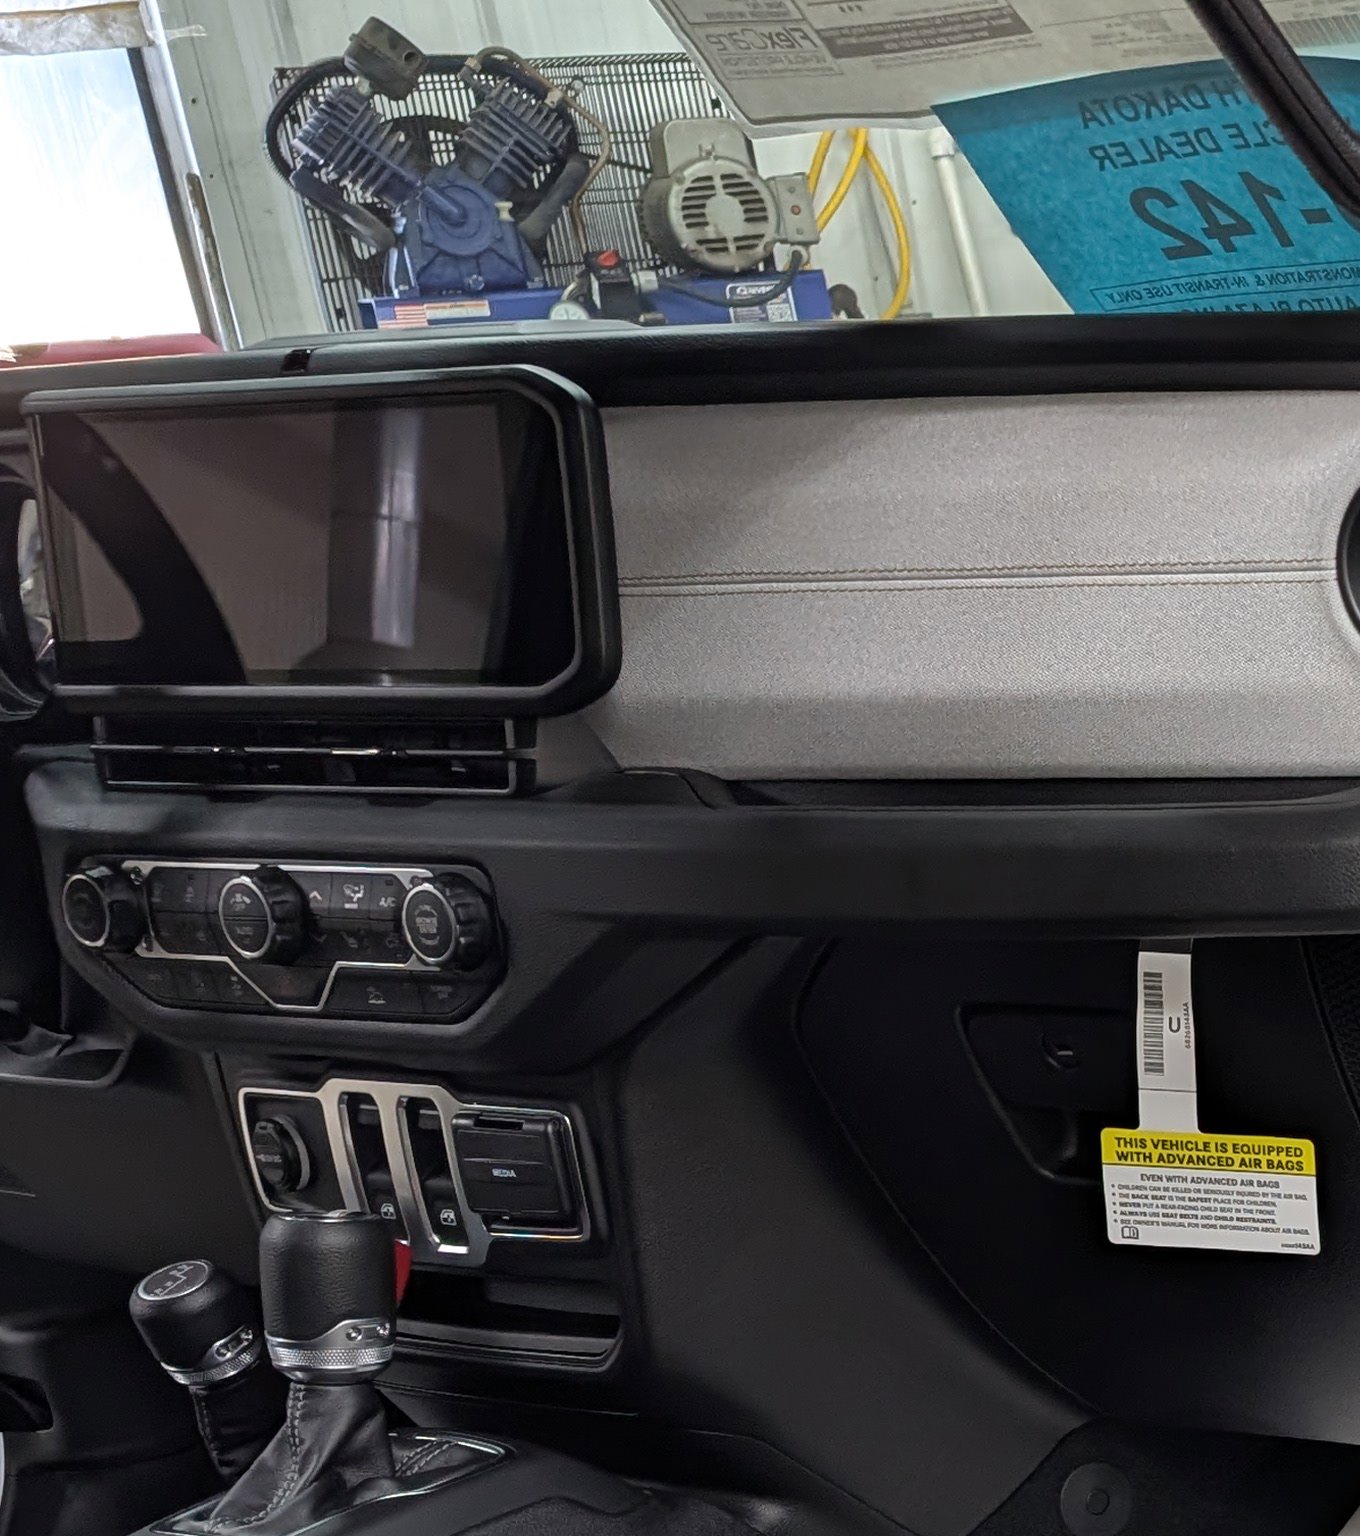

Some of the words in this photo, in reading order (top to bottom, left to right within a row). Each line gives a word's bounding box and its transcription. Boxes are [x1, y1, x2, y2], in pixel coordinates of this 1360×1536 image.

[1168, 1016, 1181, 1033] U
[1114, 1136, 1147, 1149] THIS
[1150, 1139, 1211, 1153] VEHICLE
[1215, 1142, 1228, 1154] IS
[1232, 1143, 1303, 1158] EQUIPPED
[1115, 1150, 1153, 1163] WITH
[1157, 1153, 1235, 1167] ADVANCED
[1238, 1157, 1262, 1169] AIR
[1266, 1159, 1304, 1172] BAGS
[1140, 1173, 1163, 1183] EVEN
[1165, 1174, 1188, 1184] WITH
[1190, 1176, 1238, 1187] ADVANCED
[1240, 1178, 1255, 1188] AIR
[1257, 1180, 1280, 1189] BAGS
